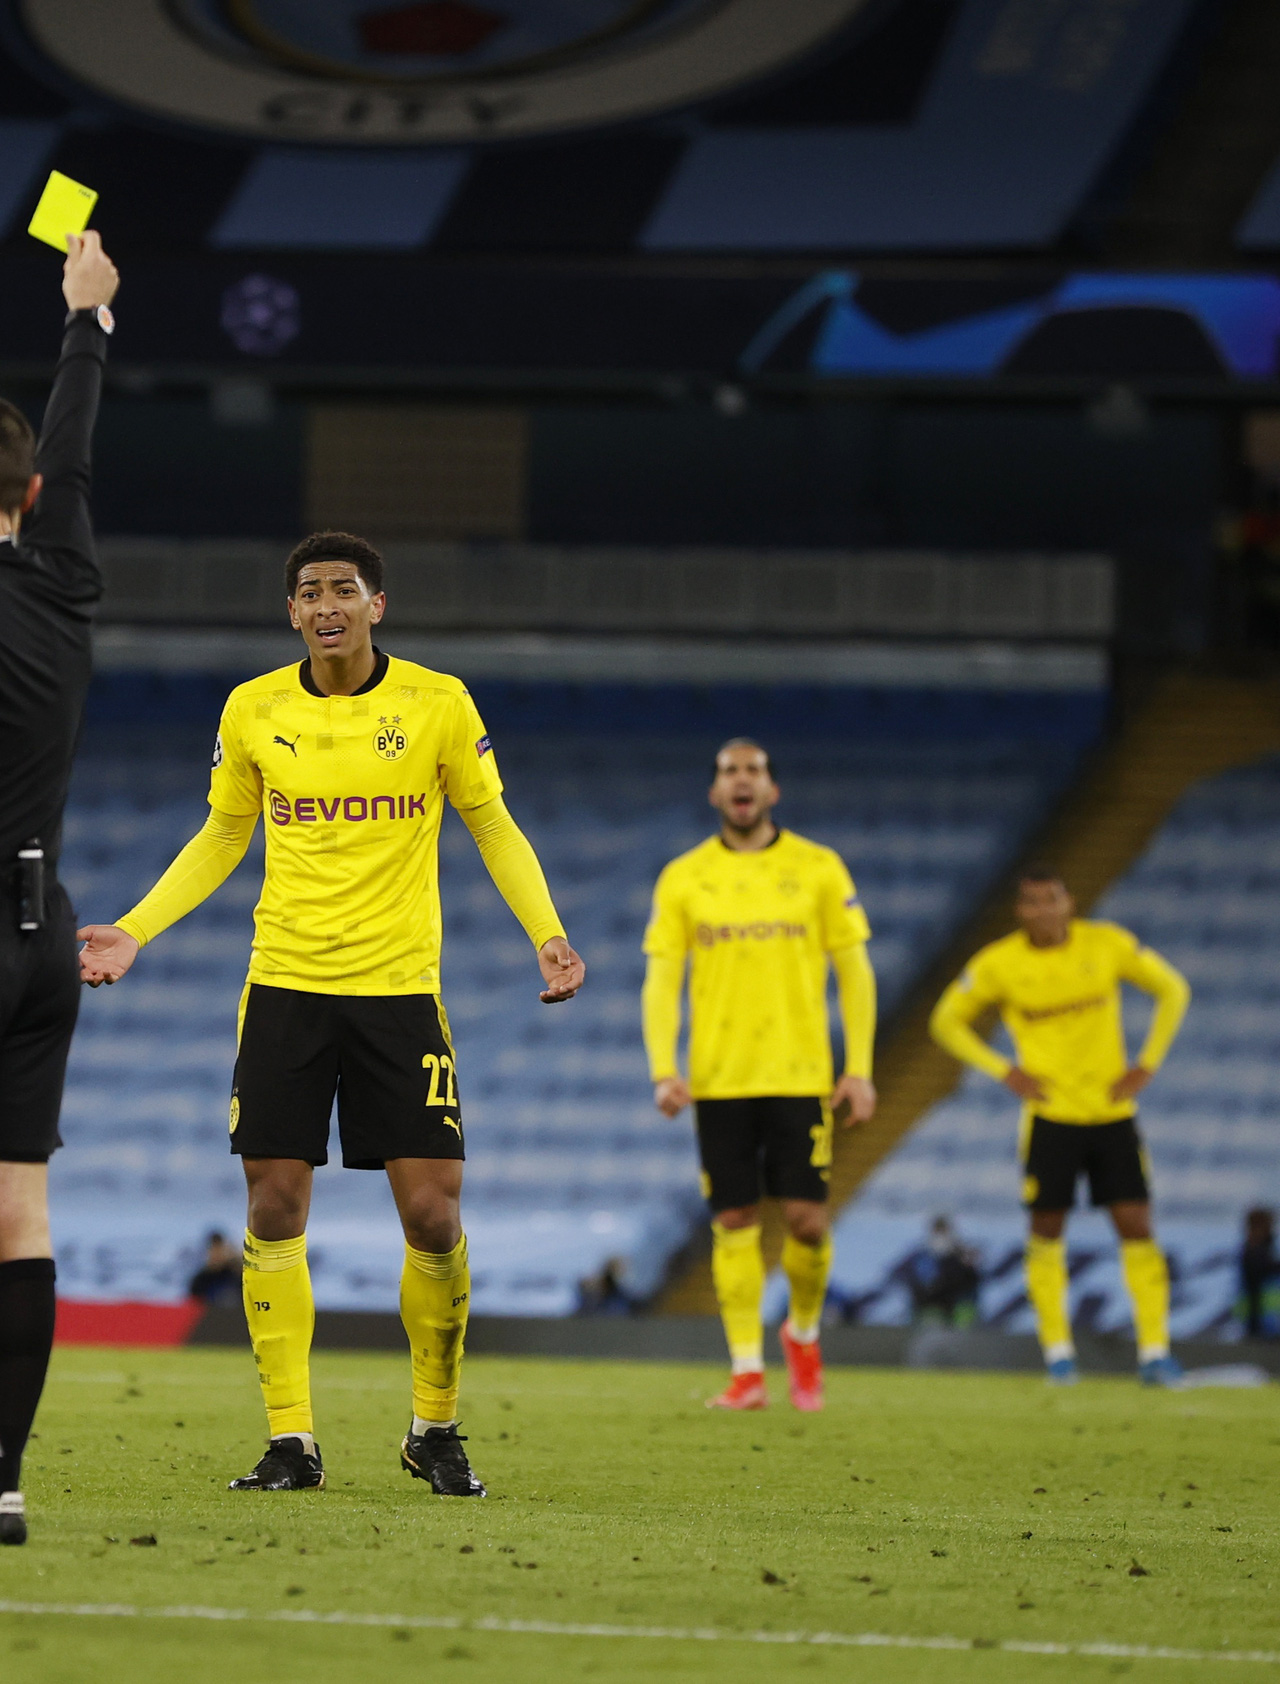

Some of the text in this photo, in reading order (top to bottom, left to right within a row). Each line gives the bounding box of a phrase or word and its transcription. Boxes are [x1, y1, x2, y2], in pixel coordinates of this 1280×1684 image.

[377, 729, 405, 751] BVB
[385, 750, 396, 758] 09
[294, 793, 426, 822] EVONIK
[421, 1053, 458, 1107] 22
